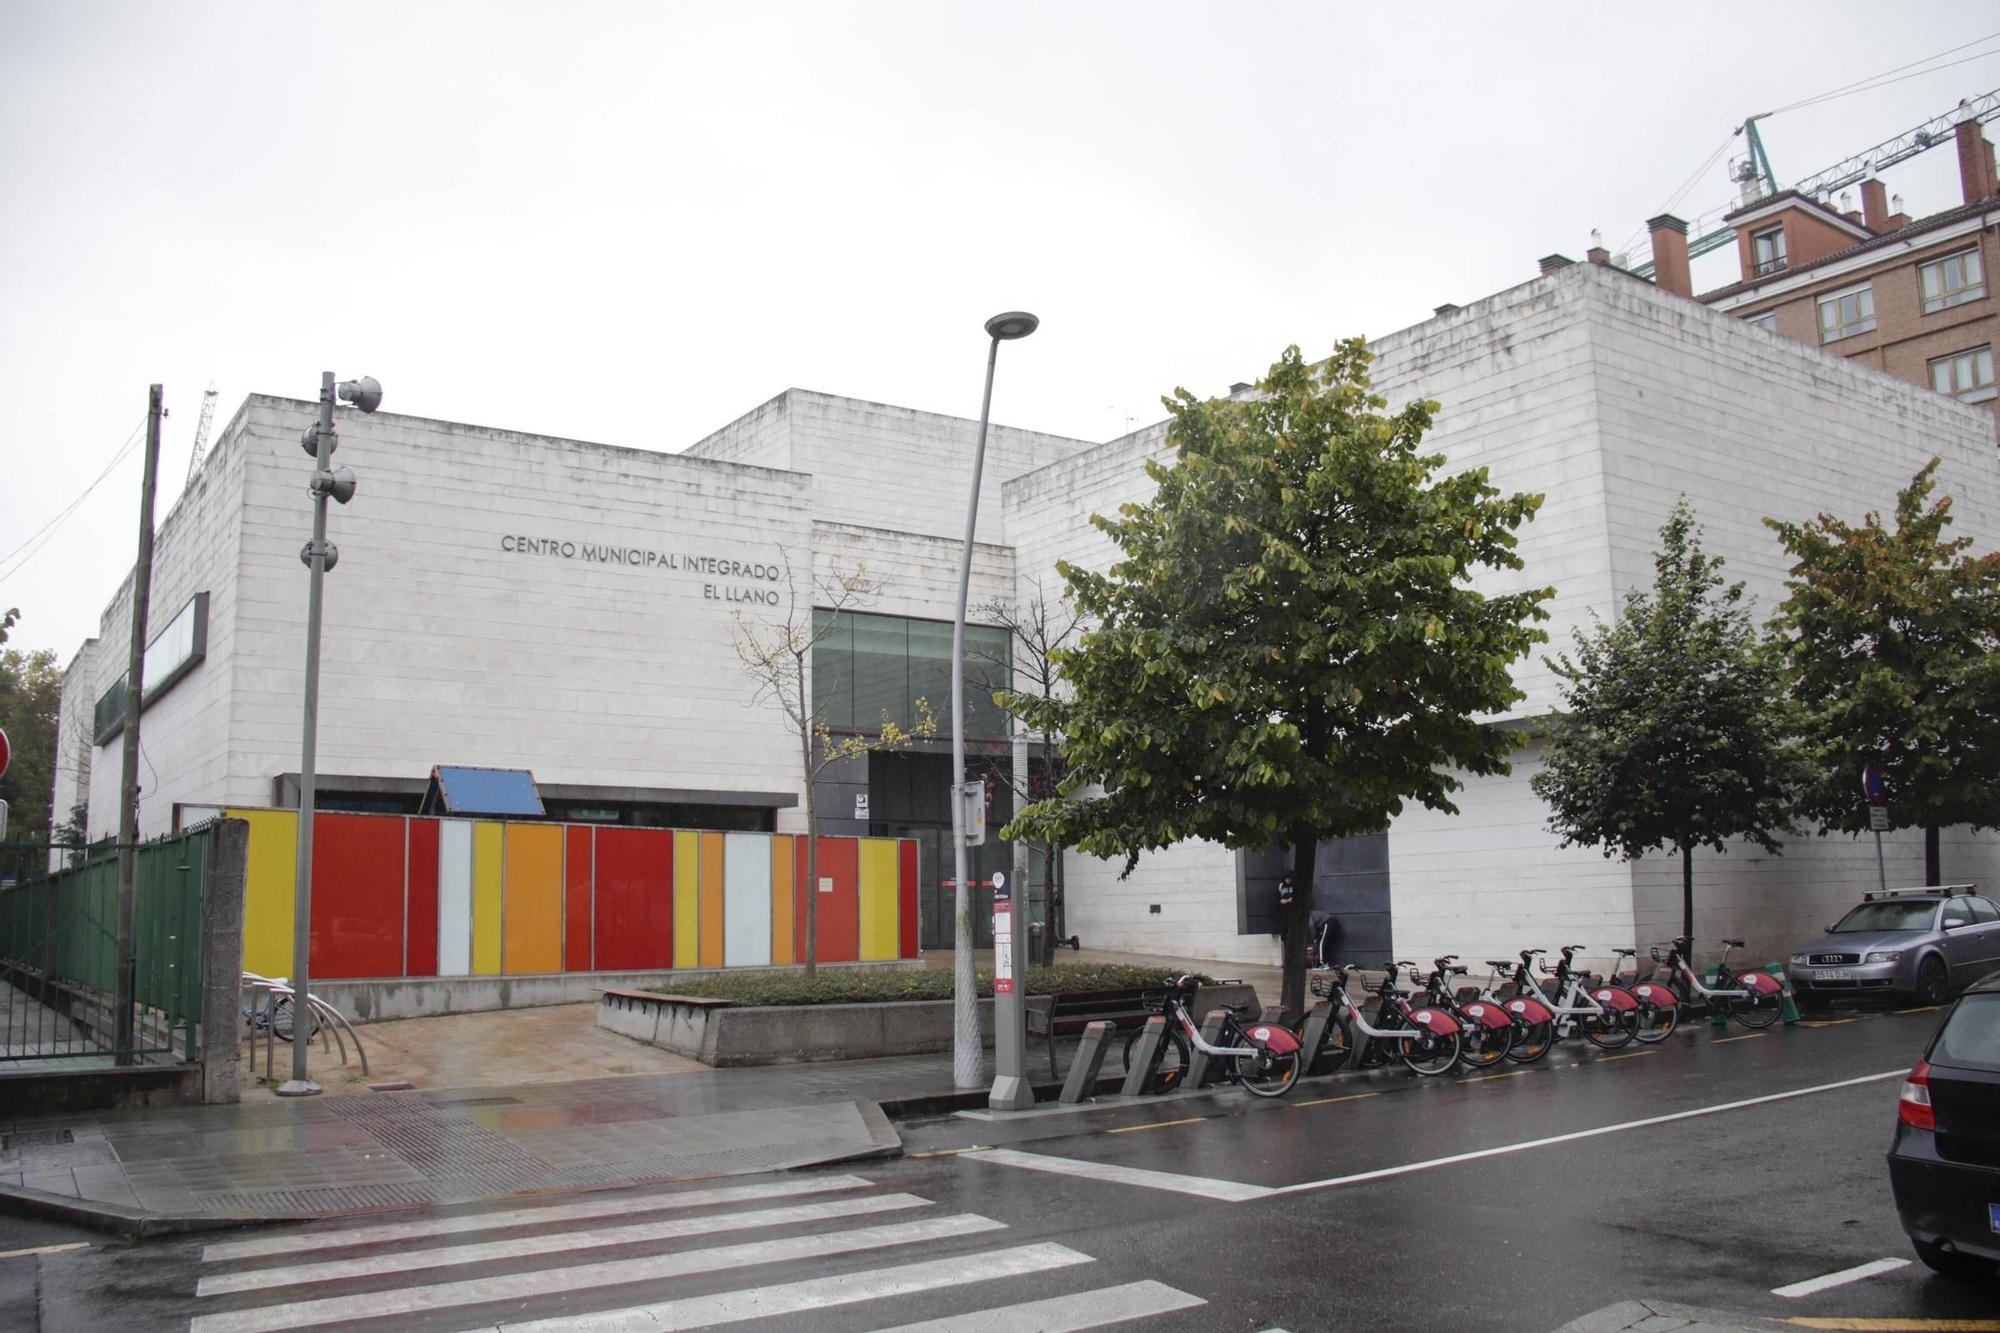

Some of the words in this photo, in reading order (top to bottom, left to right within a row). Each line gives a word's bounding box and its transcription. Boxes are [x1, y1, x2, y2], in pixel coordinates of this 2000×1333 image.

[501, 535, 576, 558] CENTRO
[581, 544, 678, 569] MUNICIPAL
[683, 555, 780, 581] INTEGRADO
[703, 584, 721, 599] EL
[726, 586, 780, 605] LLANO
